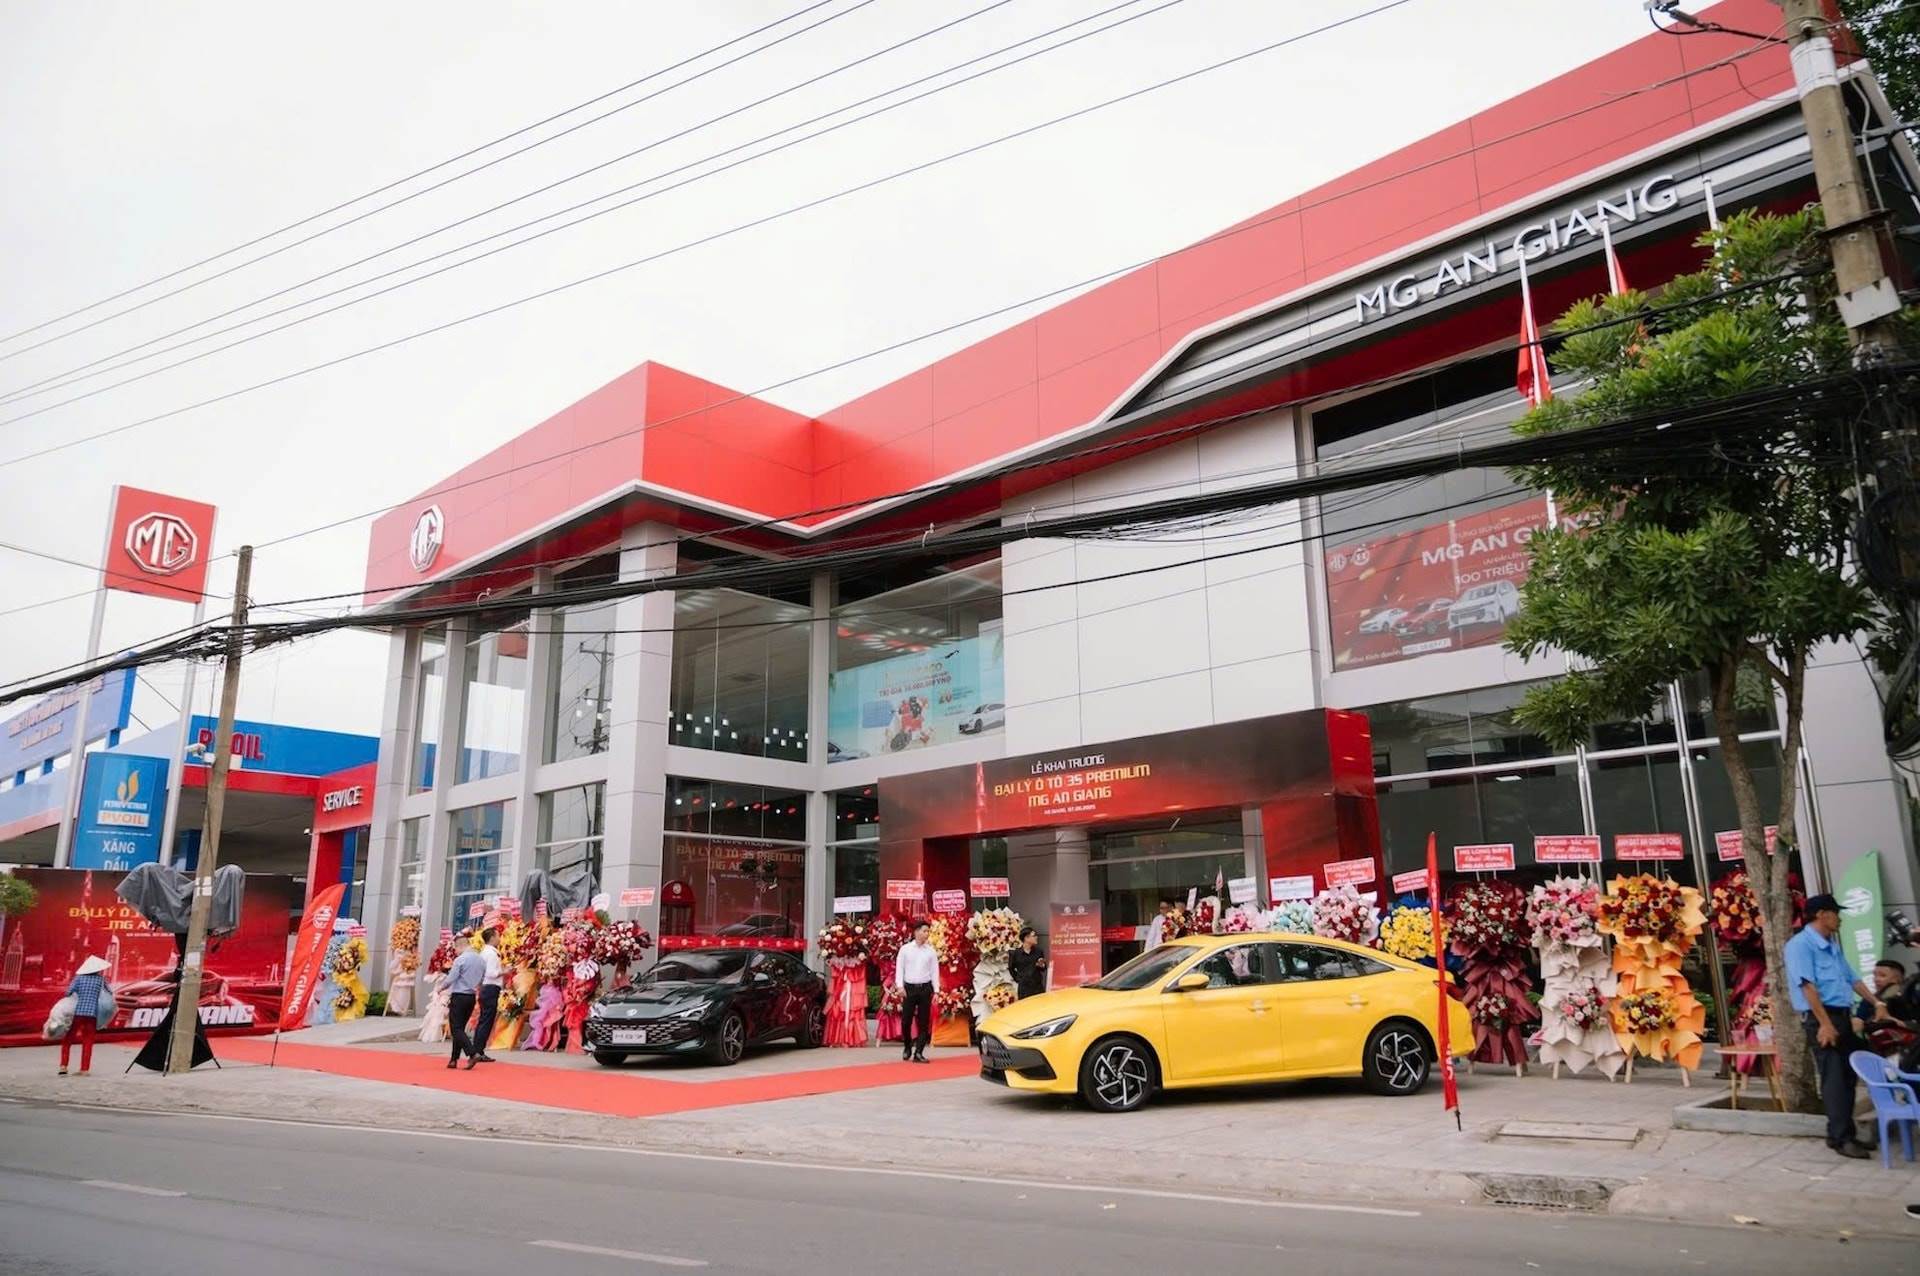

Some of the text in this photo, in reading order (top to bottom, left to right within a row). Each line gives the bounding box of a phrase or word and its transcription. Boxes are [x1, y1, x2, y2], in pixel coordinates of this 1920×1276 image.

[1356, 174, 1679, 324] MG AN GIANG
[133, 517, 191, 569] MG
[1422, 543, 1464, 567] MG
[1469, 531, 1508, 556] AN
[1457, 562, 1525, 585] 100 TRIỆU
[199, 728, 265, 761] POIL
[1044, 759, 1066, 774] KHAI
[995, 764, 1151, 798] ĐẠI LÝ Ô TÔ 3S PREMIUM
[323, 785, 361, 811] SERVICE
[1028, 785, 1112, 807] MG AN GIANG
[101, 812, 146, 825] PVOIL
[102, 838, 135, 854] XĂNG
